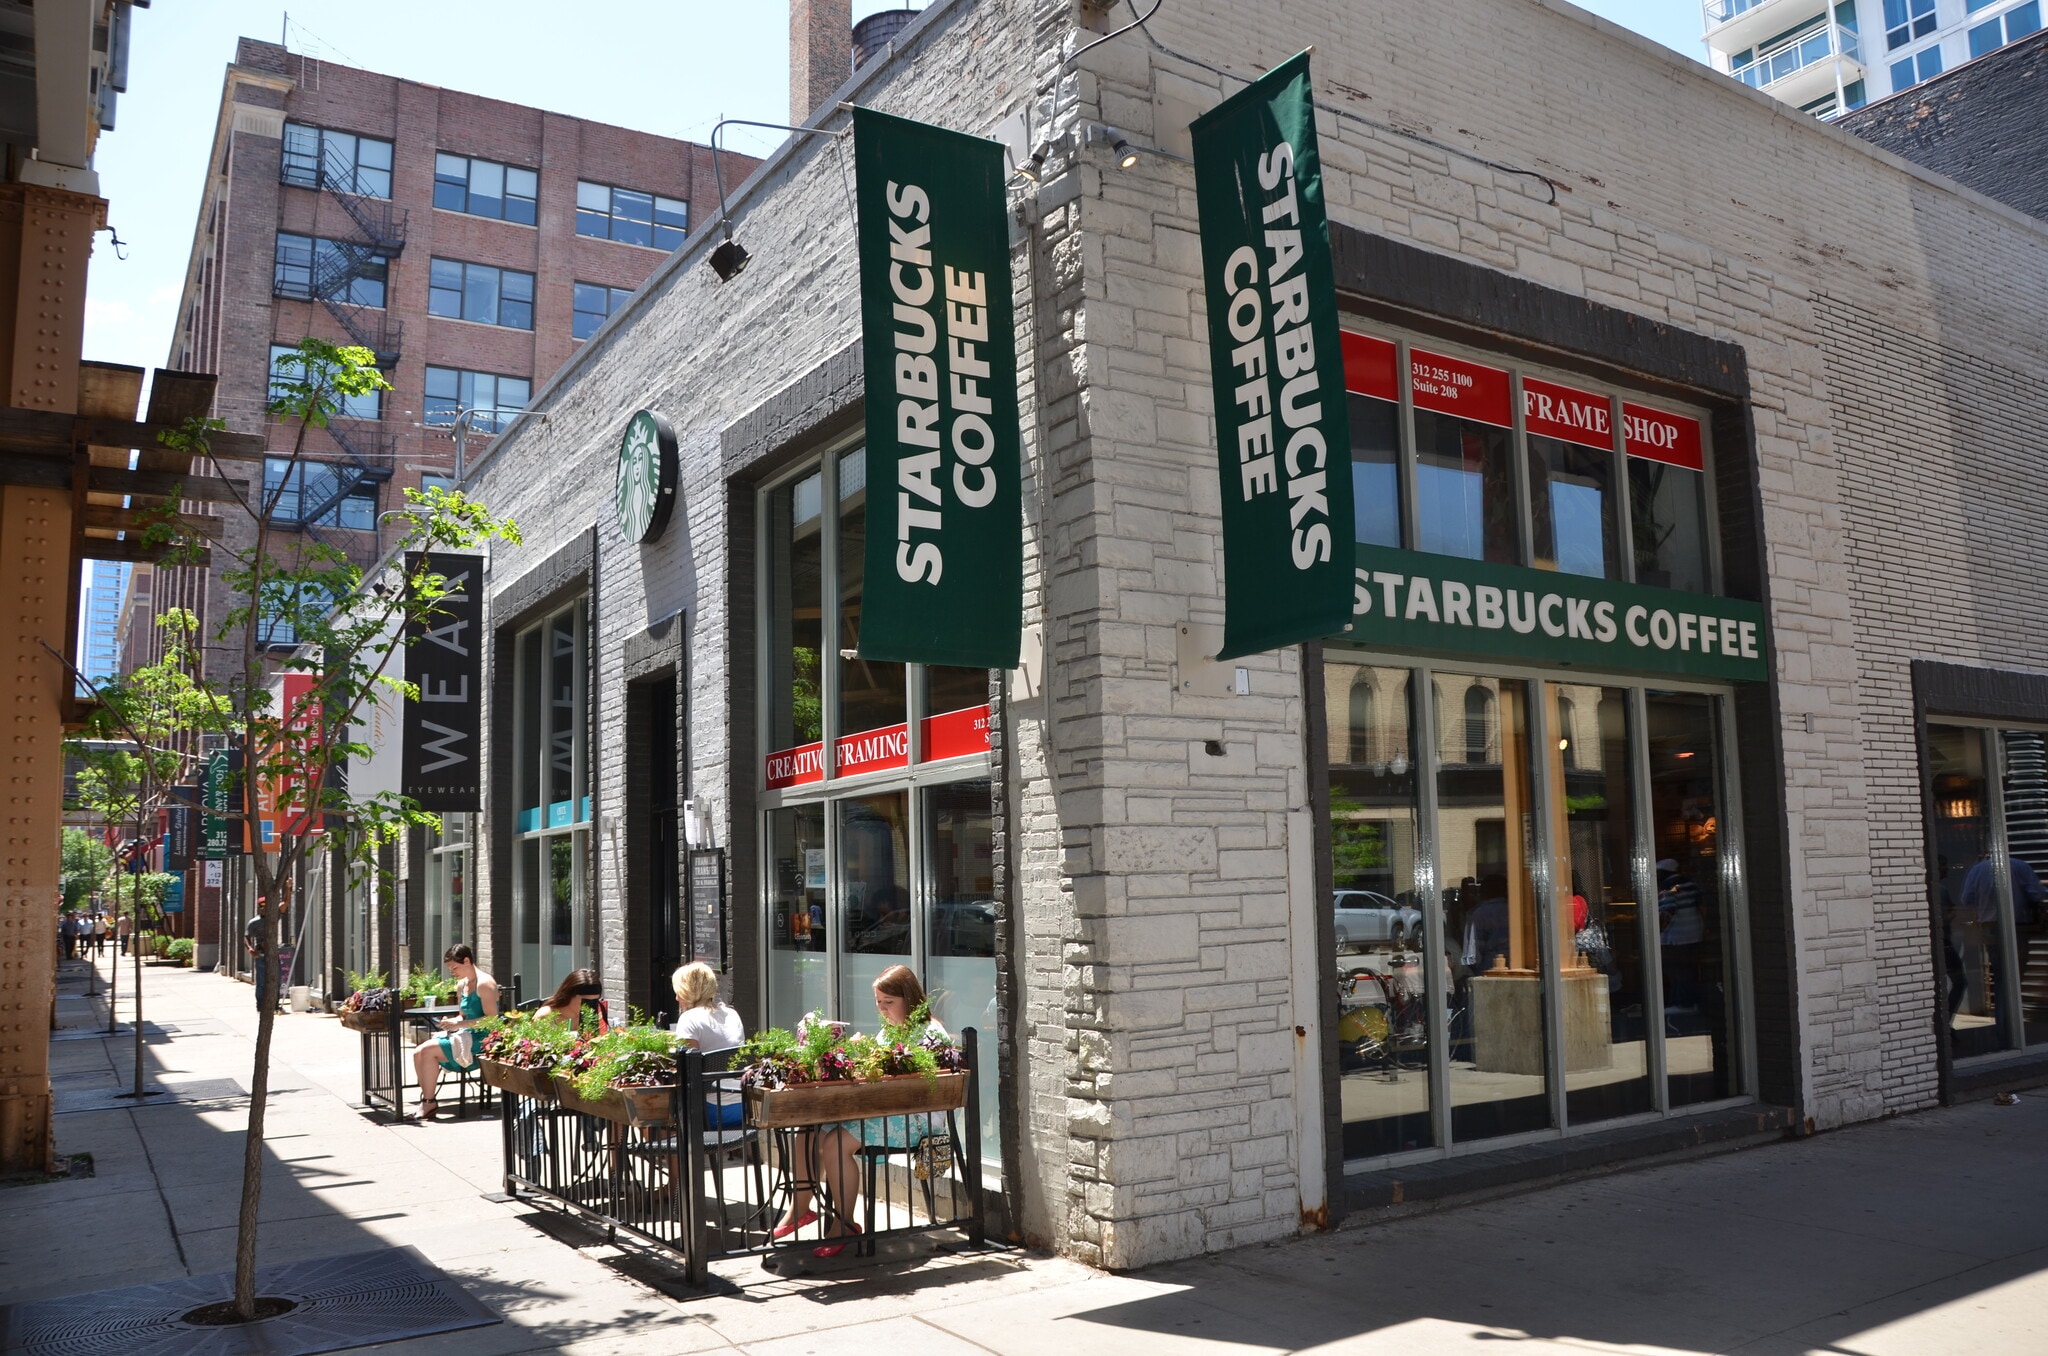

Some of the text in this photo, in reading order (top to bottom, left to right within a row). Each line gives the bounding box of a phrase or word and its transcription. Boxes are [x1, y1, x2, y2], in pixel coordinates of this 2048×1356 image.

[886, 179, 943, 586] STARBUCKS
[944, 266, 997, 508] COFFEE
[1224, 245, 1278, 502] COFFEE
[1257, 140, 1331, 570] STARBUCKS
[1412, 362, 1473, 388] 312 255 1100
[1413, 378, 1458, 399] Suite 208
[1523, 390, 1678, 450] FRAME SHOP
[1353, 567, 1759, 659] STARBUCKS COFFEE
[421, 570, 469, 774] WEAR
[836, 731, 908, 767] FRAMING
[974, 718, 985, 730] 312
[408, 786, 475, 794] EYEWEAR
